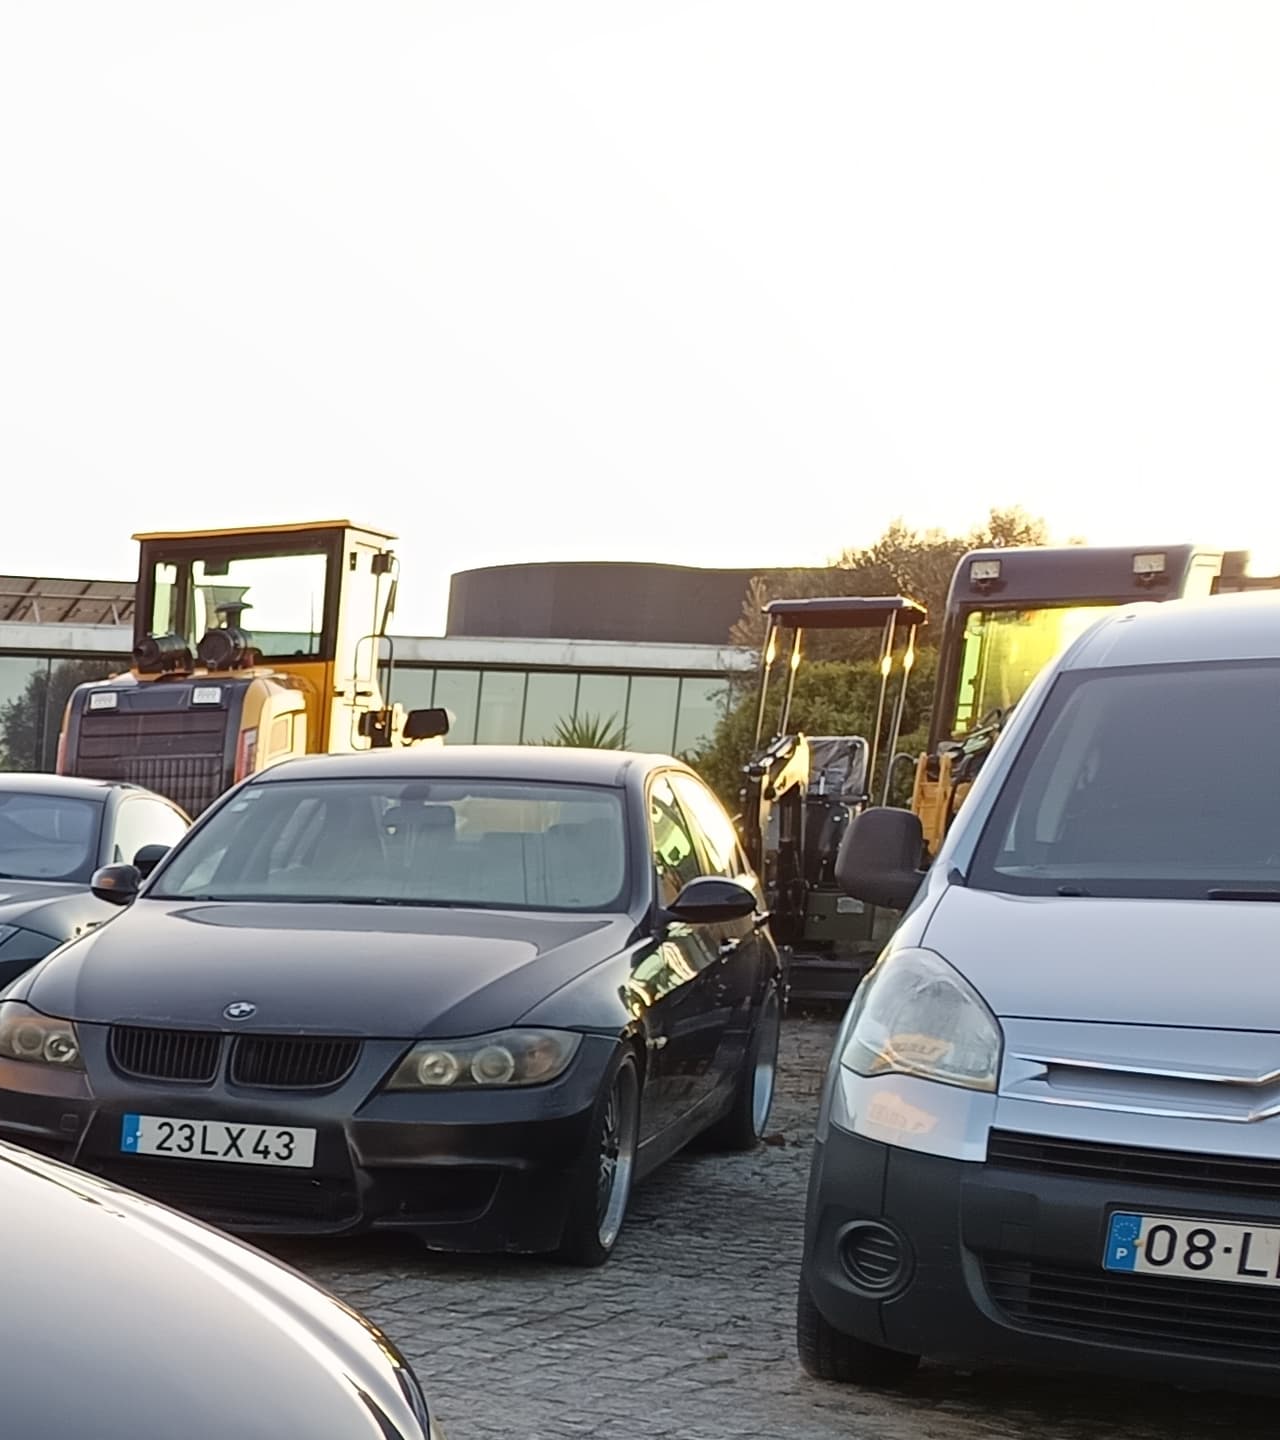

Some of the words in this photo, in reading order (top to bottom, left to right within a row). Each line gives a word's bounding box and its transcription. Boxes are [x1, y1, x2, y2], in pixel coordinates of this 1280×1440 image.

[156, 1122, 296, 1161] 23LX43
[1116, 1247, 1128, 1260] P
[1145, 1224, 1280, 1279] 08-L
